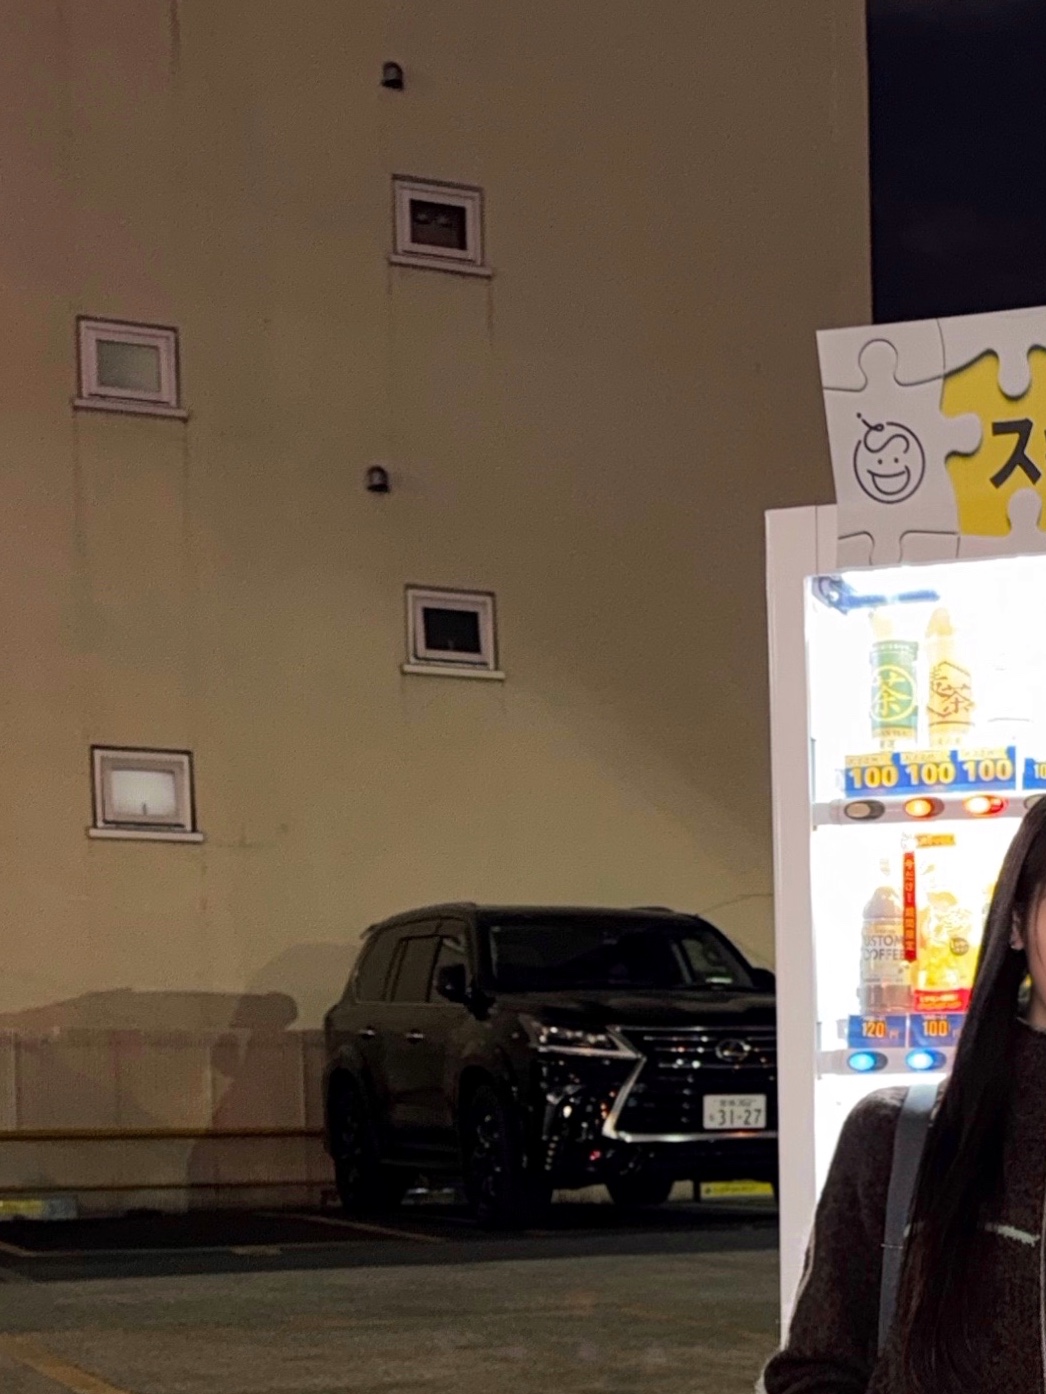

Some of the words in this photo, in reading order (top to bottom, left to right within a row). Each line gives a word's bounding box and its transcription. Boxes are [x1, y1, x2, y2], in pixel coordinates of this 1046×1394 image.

[850, 765, 898, 788] 100
[906, 762, 956, 785] 100
[963, 758, 1013, 782] 100
[861, 1021, 886, 1038] 120
[922, 1020, 949, 1036] 100
[718, 1108, 762, 1126] 31-27
